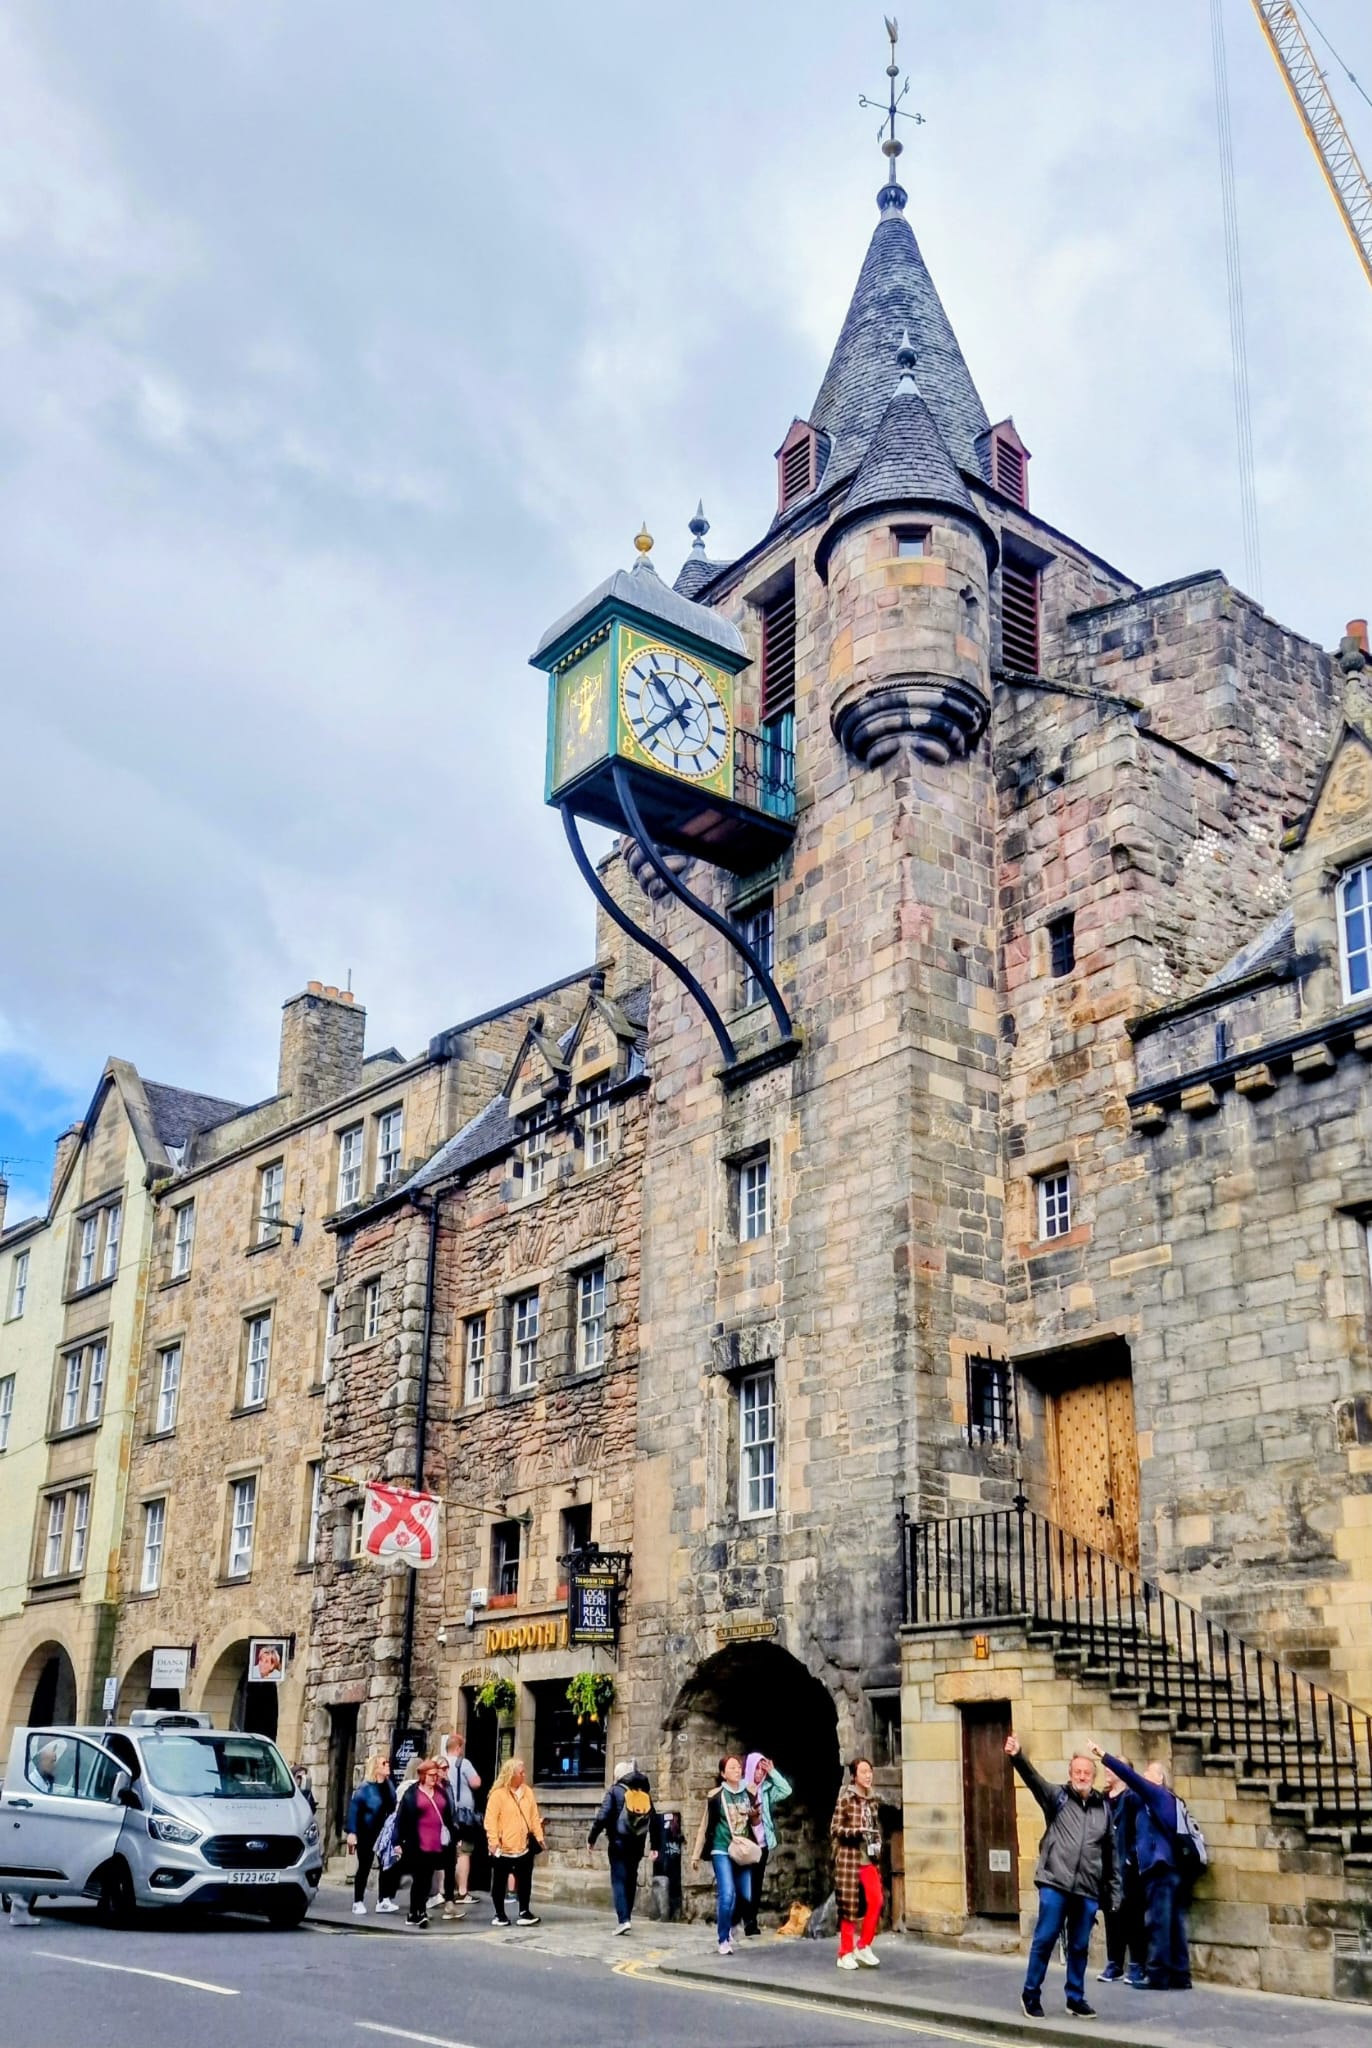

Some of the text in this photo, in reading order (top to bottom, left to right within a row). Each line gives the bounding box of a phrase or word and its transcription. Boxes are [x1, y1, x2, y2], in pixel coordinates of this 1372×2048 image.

[622, 735, 635, 756] 8
[715, 776, 727, 792] 4
[583, 1589, 605, 1597] LOCAL
[583, 1596, 607, 1605] BEERS
[583, 1606, 607, 1617] REAL
[582, 1616, 607, 1627] ALES
[485, 1622, 557, 1654] TOLBOOTH
[233, 1872, 277, 1882] ST23 KGZ
